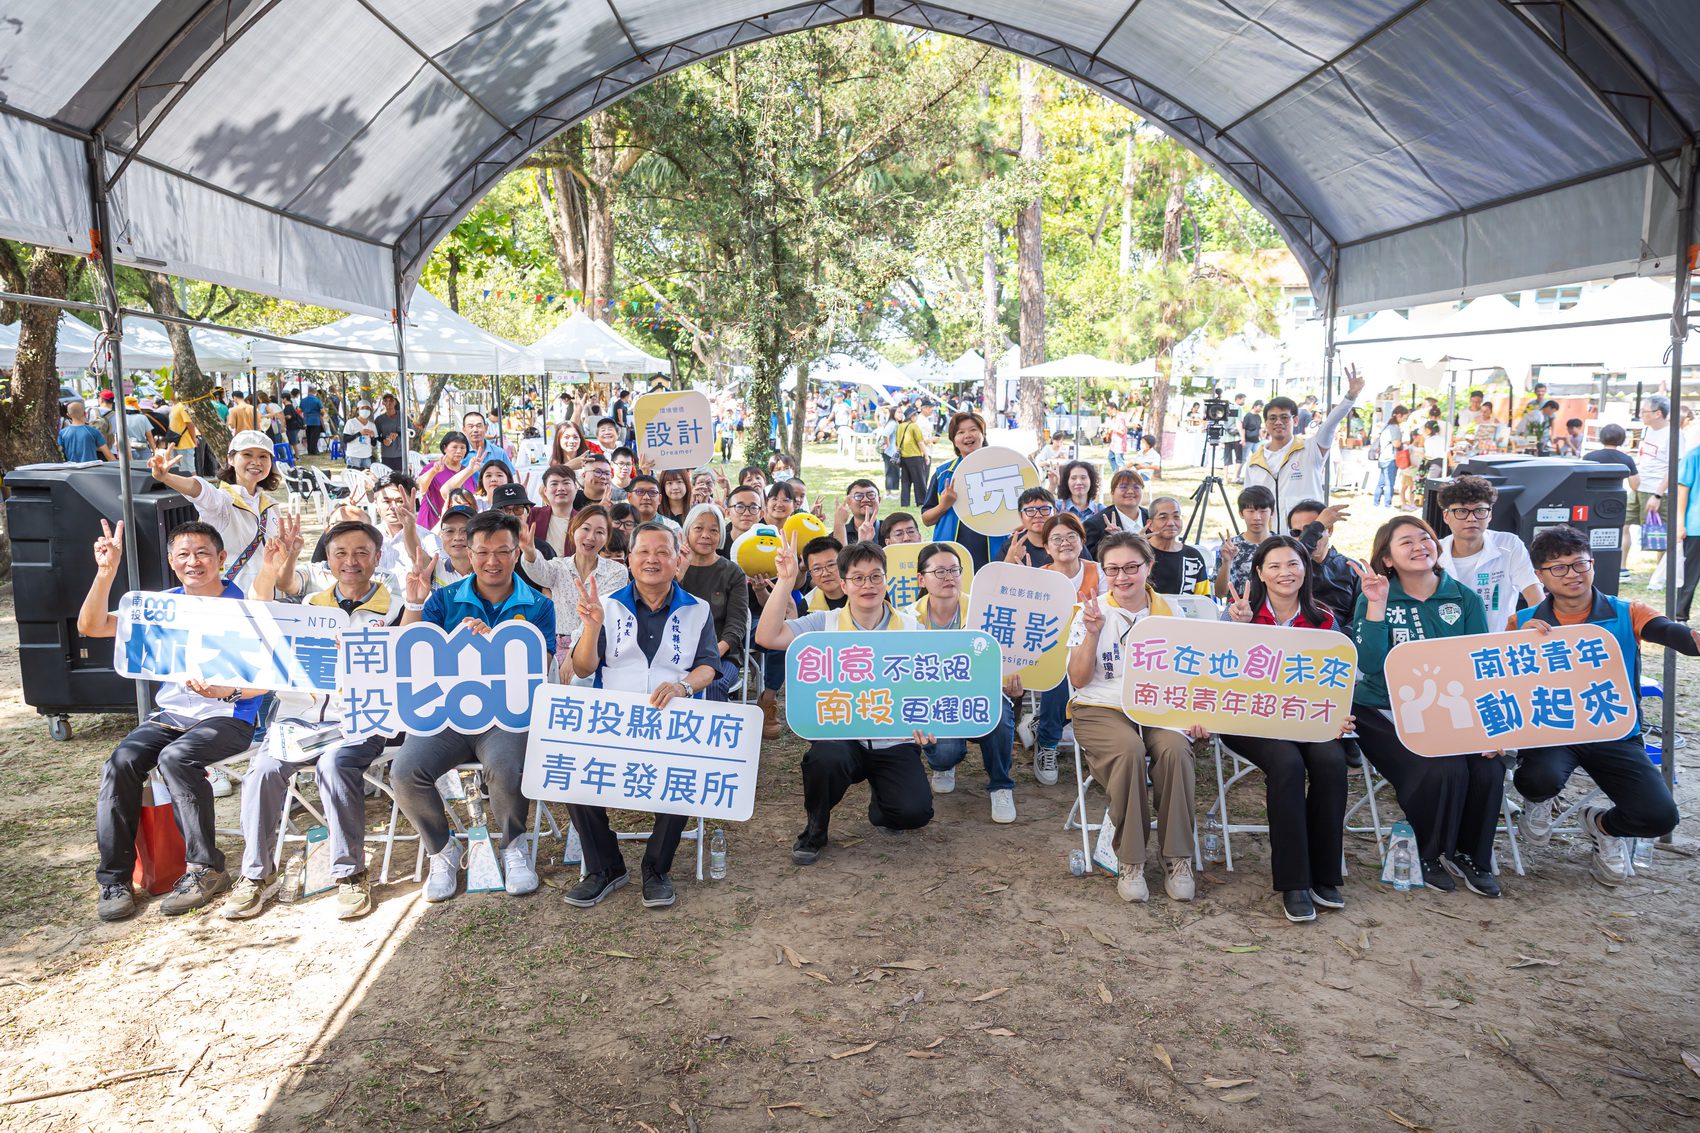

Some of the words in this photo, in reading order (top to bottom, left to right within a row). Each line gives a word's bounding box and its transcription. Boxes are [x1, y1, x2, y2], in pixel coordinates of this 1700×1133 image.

[645, 419, 703, 448] 設計
[964, 464, 1024, 516] 玩
[1577, 508, 1584, 520] 1
[131, 595, 142, 620] 南投
[1000, 585, 1051, 601] 數位影音創作
[980, 604, 1058, 653] 攝影
[797, 645, 875, 682] 創意
[884, 655, 970, 682] 不設限
[1002, 655, 1039, 666] esigner
[1131, 639, 1352, 688] 玩在地創未來
[1471, 638, 1609, 679] 南投青年
[342, 627, 394, 734] 南投
[817, 689, 894, 724] 南投
[902, 697, 990, 724] 更耀眼
[1134, 682, 1337, 722] 南投青年超有才
[1476, 680, 1628, 737] 動起來
[548, 696, 745, 749] 南投縣政府
[542, 753, 739, 808] 青年發展所
